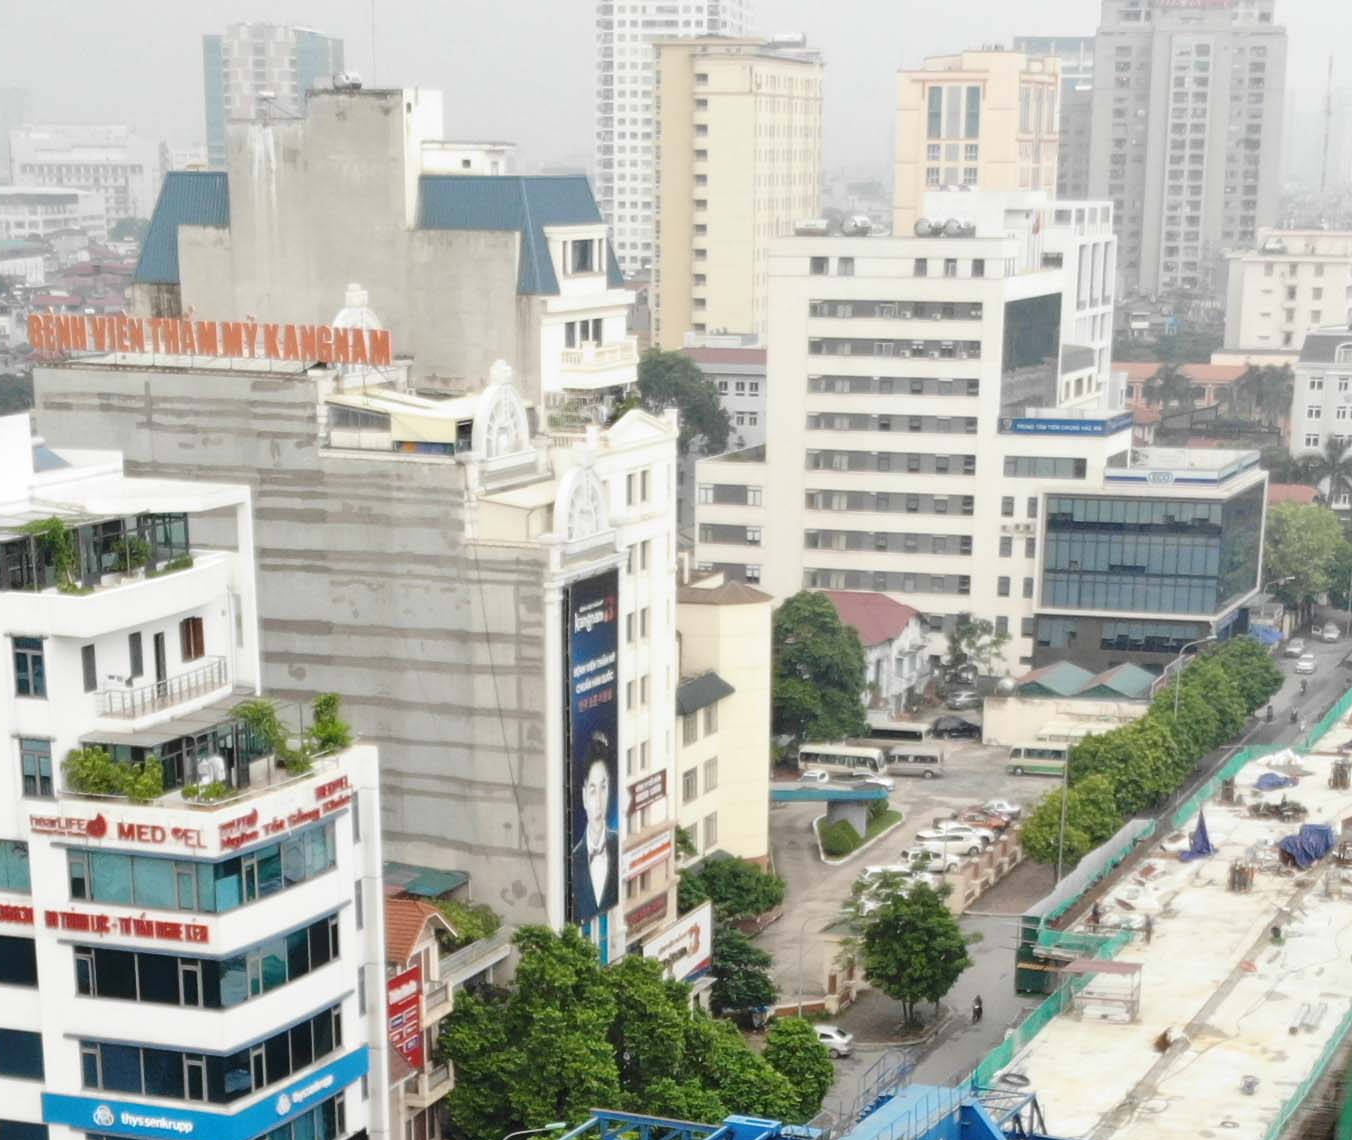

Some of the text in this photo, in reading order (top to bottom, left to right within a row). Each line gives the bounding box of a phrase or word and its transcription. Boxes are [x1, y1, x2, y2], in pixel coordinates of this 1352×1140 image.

[263, 322, 393, 366] KANGNAM
[117, 822, 167, 844] MED
[121, 1112, 194, 1134] thyssenkrupp
